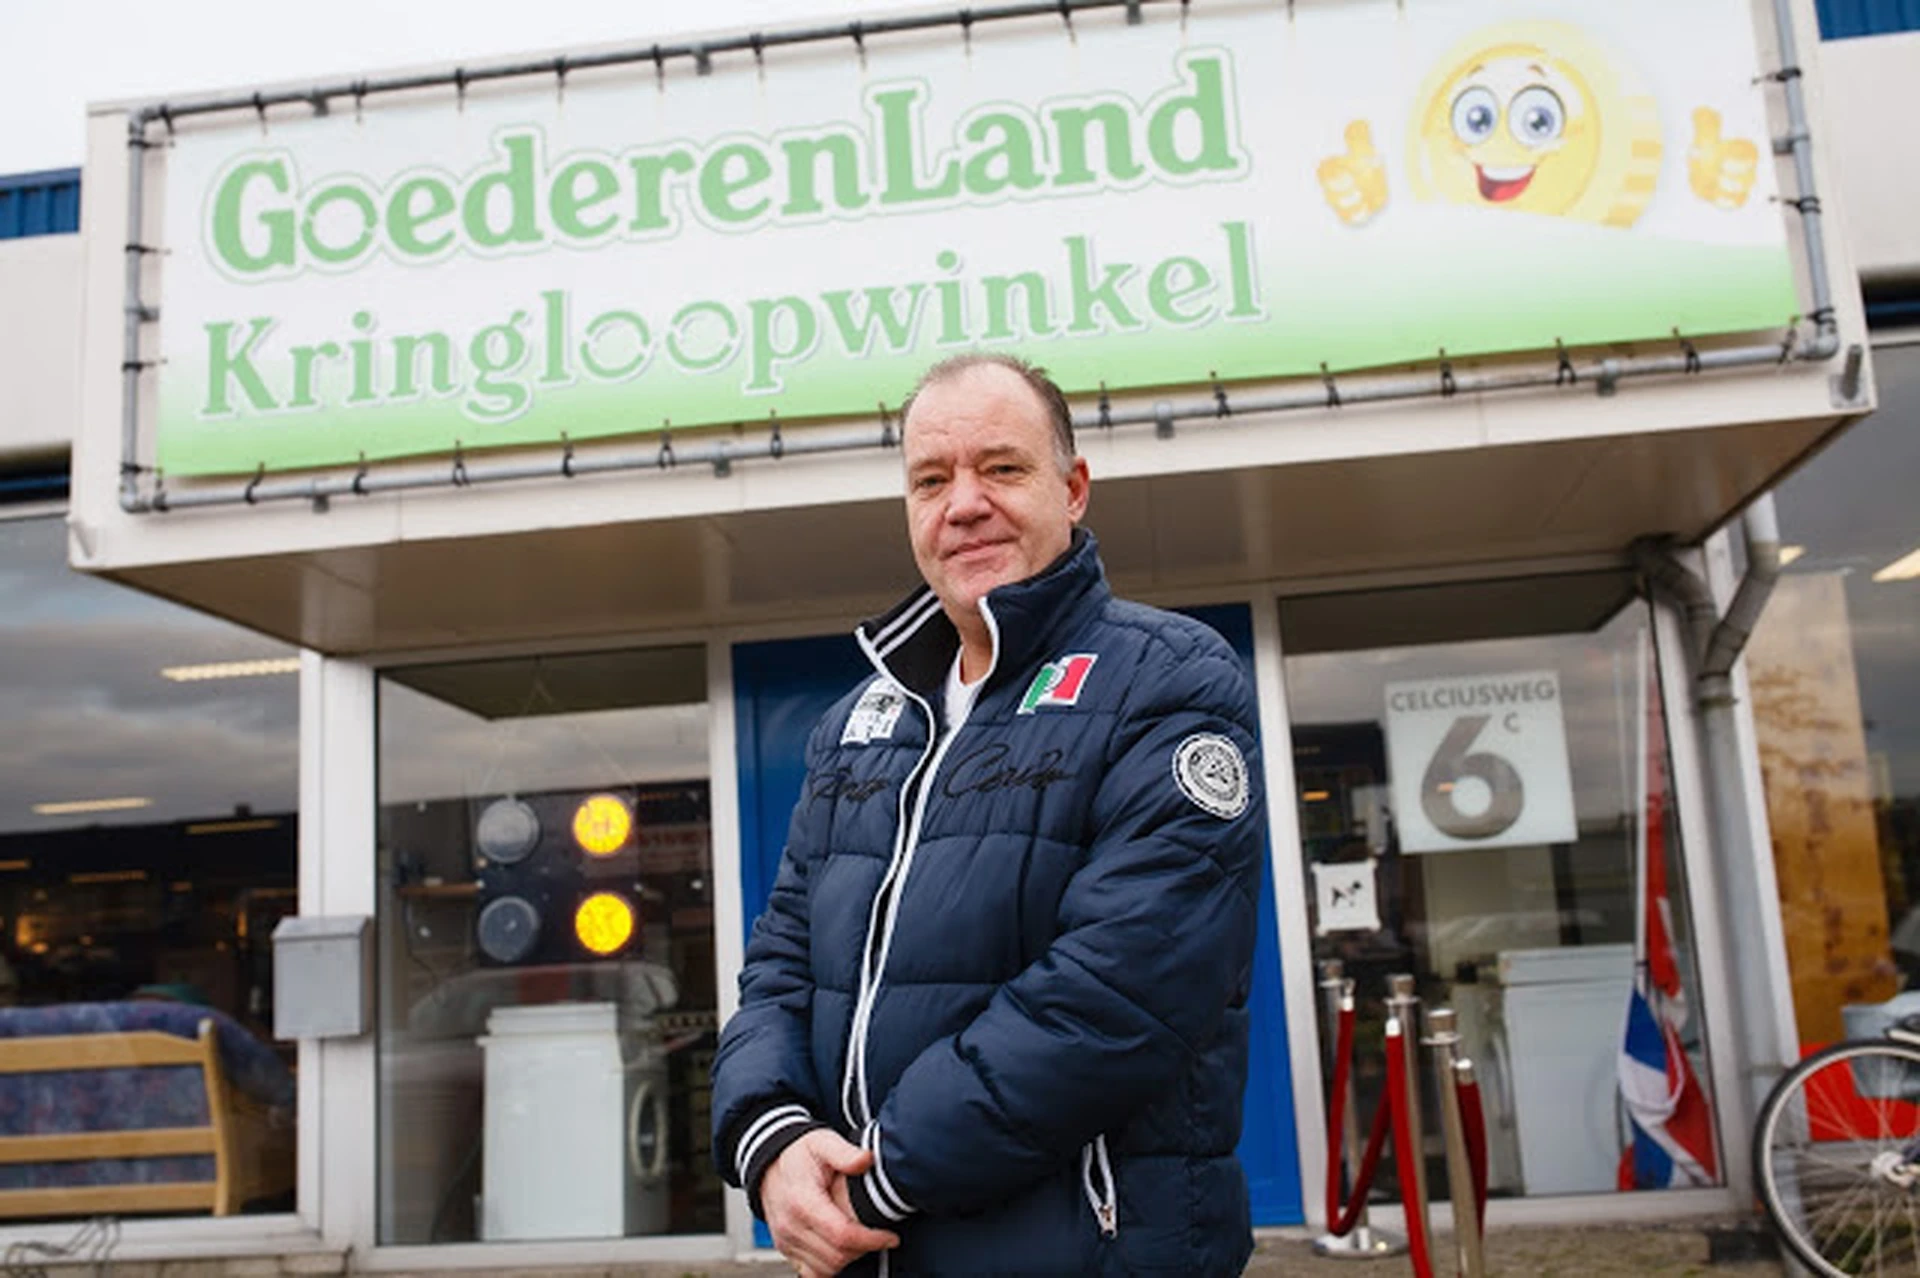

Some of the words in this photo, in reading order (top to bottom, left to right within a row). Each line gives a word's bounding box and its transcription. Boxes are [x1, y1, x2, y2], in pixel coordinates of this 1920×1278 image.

[210, 55, 1241, 275] GoederenLand
[200, 219, 1264, 419] Kringloopwinkel
[1390, 679, 1556, 712] CELCIUSWEG
[1420, 714, 1525, 841] 6
